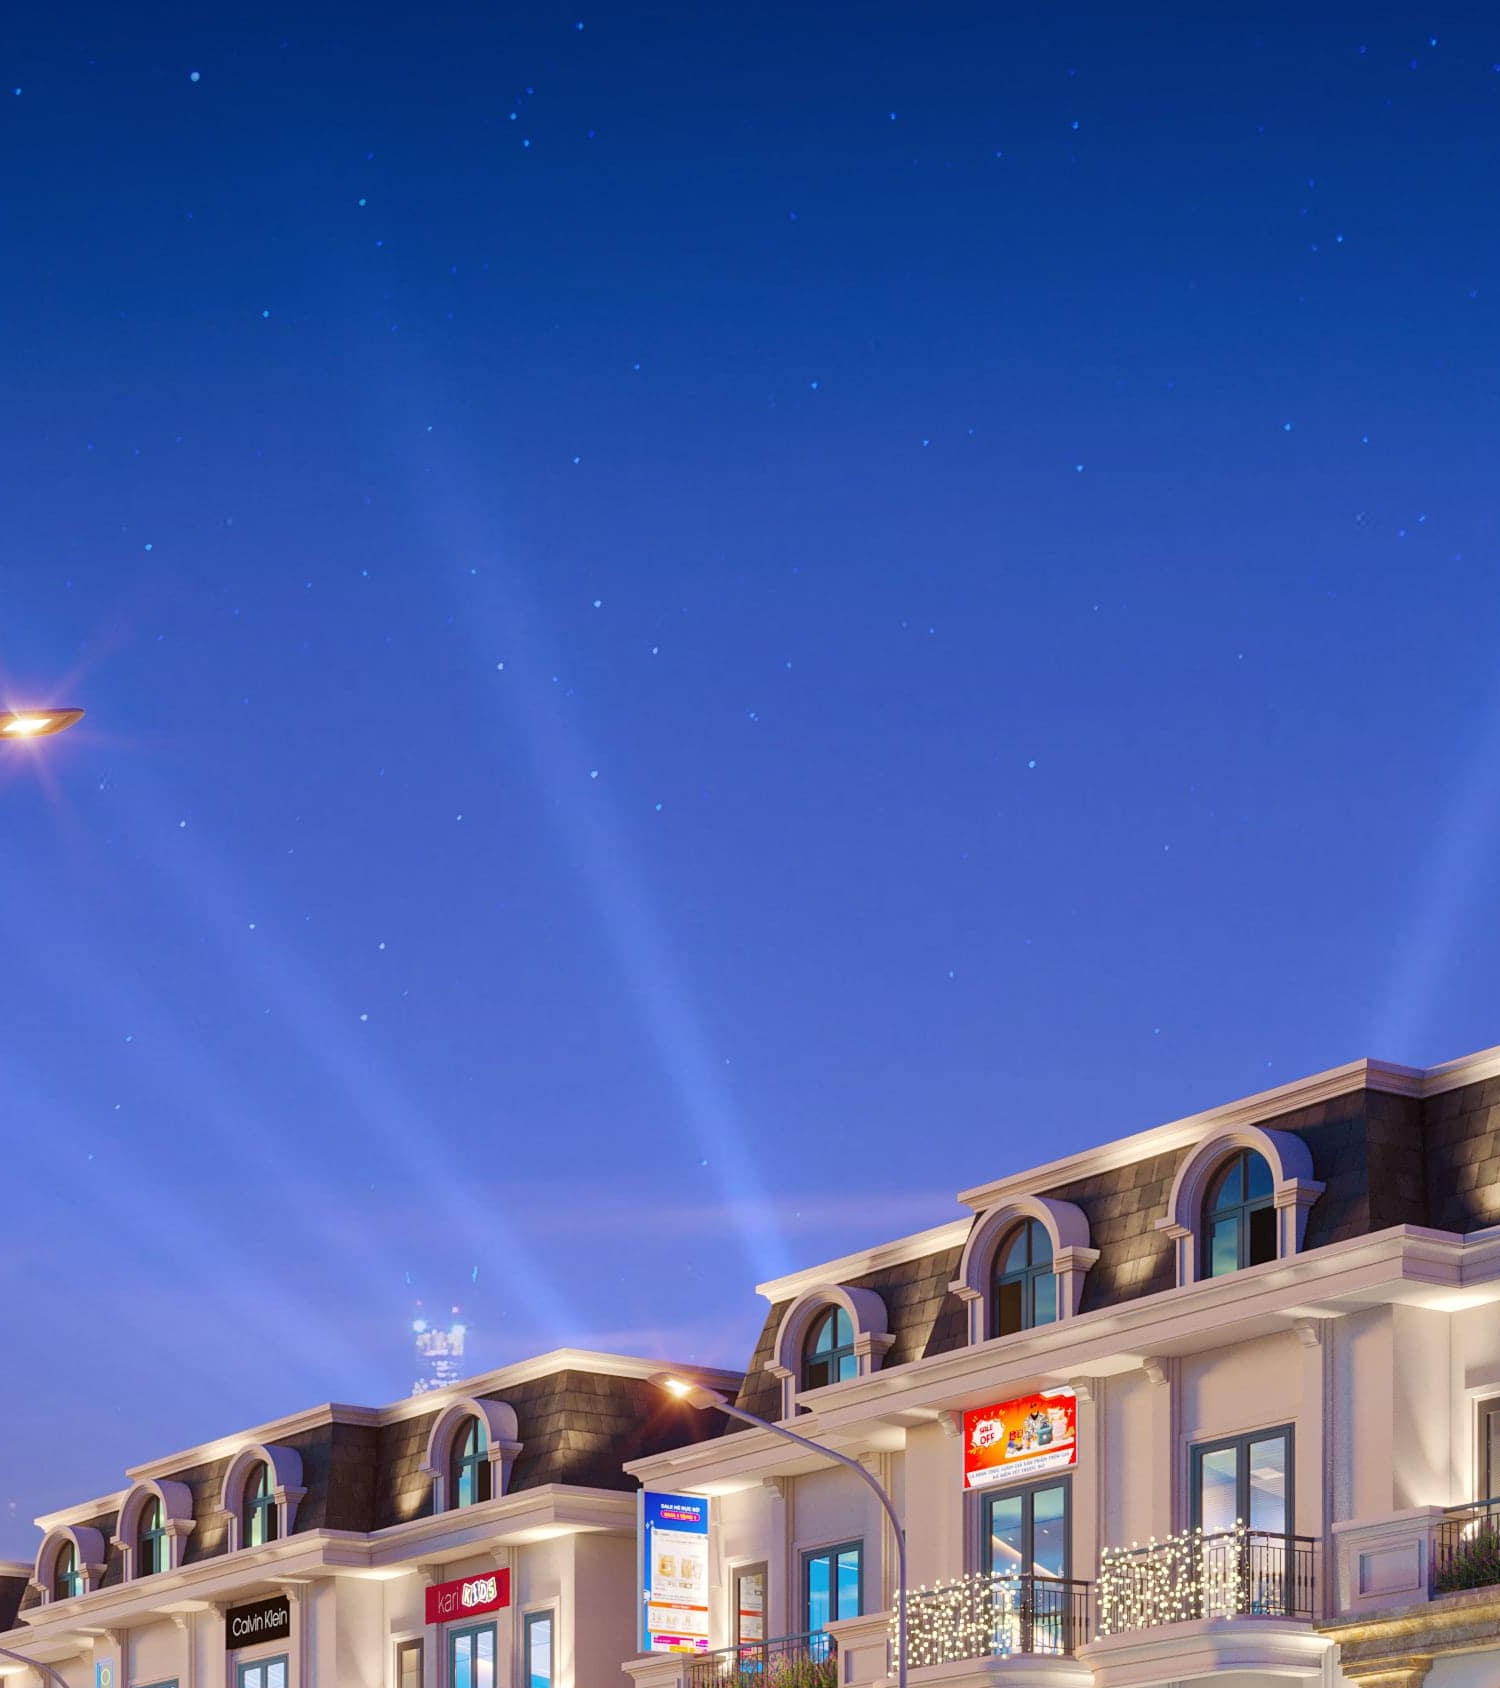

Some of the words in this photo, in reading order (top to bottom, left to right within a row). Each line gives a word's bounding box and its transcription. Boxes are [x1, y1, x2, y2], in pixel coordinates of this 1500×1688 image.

[980, 1432, 995, 1446] OFF
[438, 1590, 460, 1615] kari
[461, 1576, 498, 1608] KIDS
[232, 1615, 263, 1637] Calvin
[264, 1608, 288, 1628] Klein
